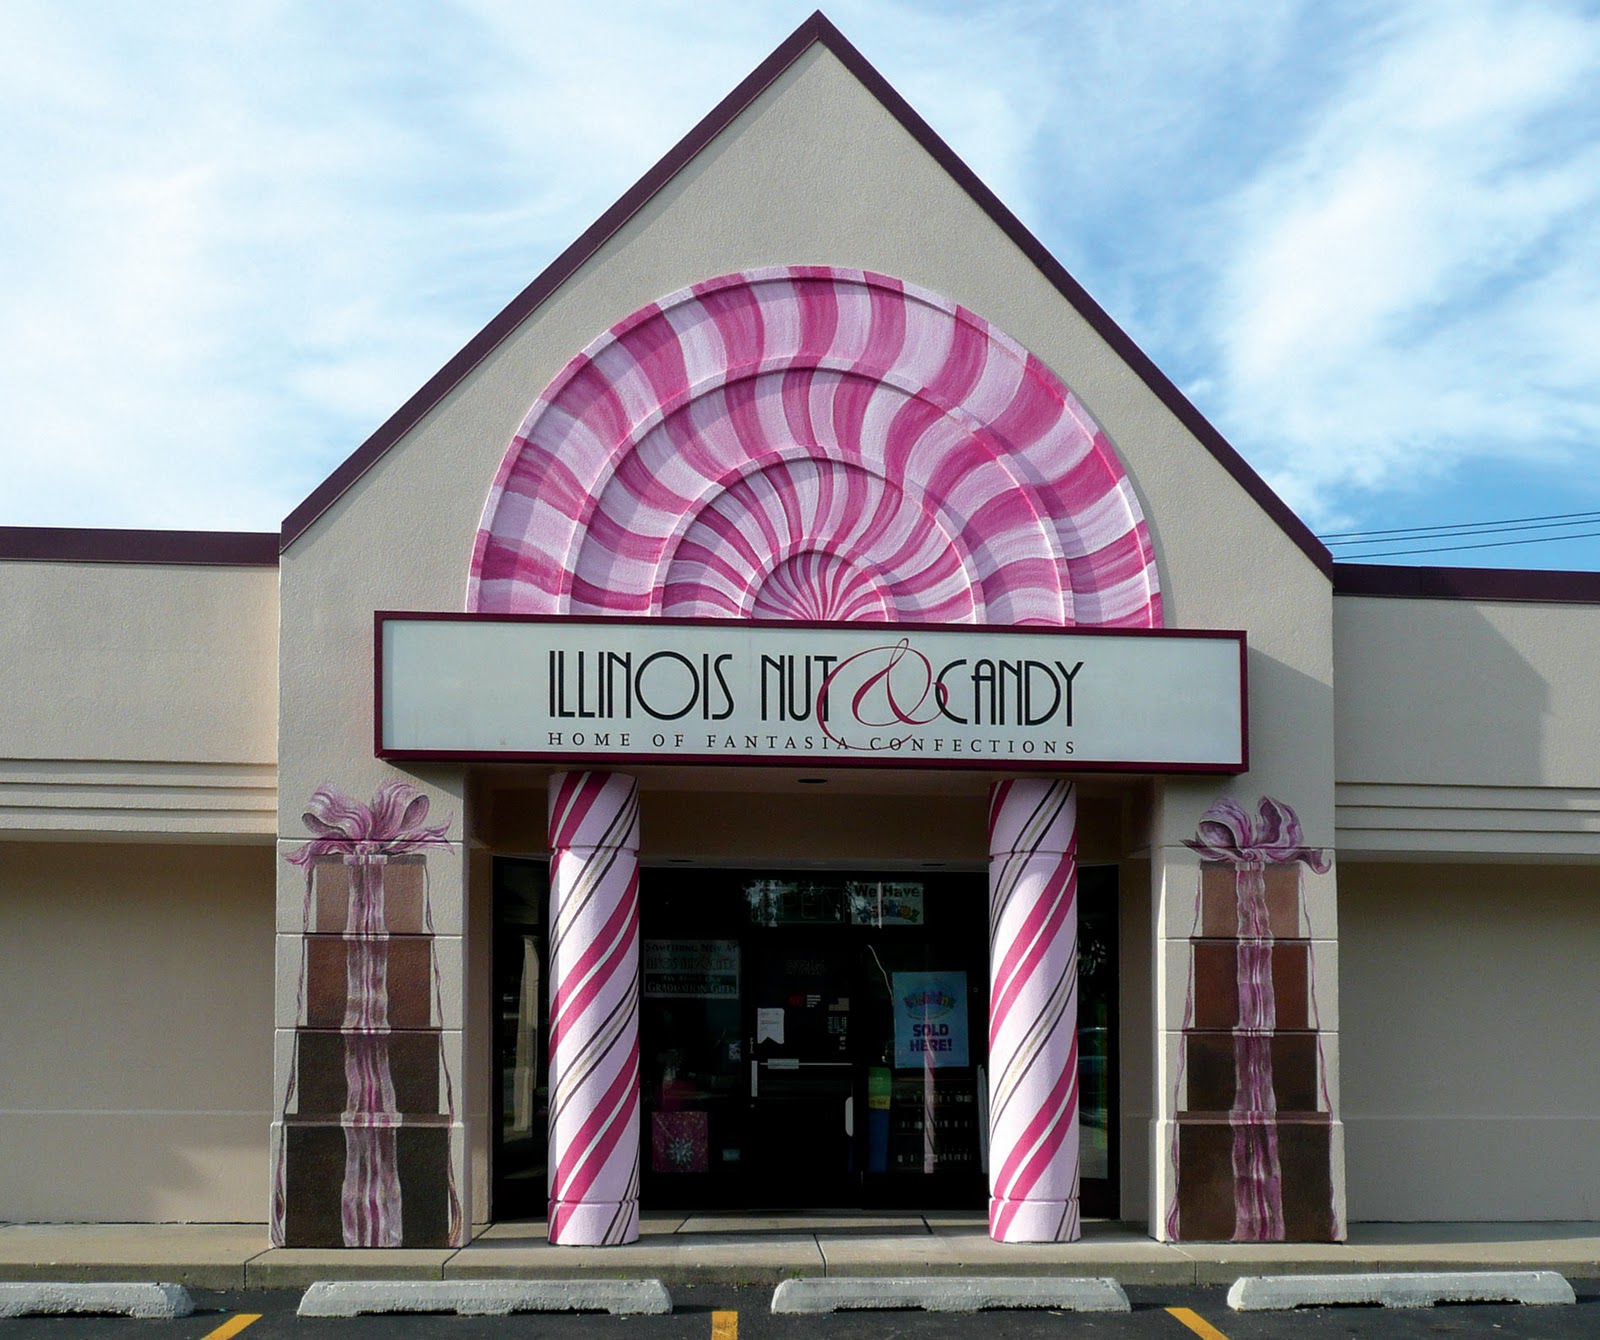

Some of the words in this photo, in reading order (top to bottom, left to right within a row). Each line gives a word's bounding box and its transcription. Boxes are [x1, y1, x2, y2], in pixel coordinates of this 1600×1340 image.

[549, 650, 735, 721] ILLINOIS
[760, 654, 838, 722] NUT
[934, 658, 1085, 727] CANDY
[548, 732, 631, 747] HOME
[652, 733, 685, 748] OF
[706, 734, 850, 750] FANTASIA
[869, 736, 1075, 754] CONFECTIONS
[853, 884, 877, 898] We
[882, 884, 920, 898] Have
[913, 1023, 949, 1037] SOLD
[910, 1038, 953, 1052] HERE!
